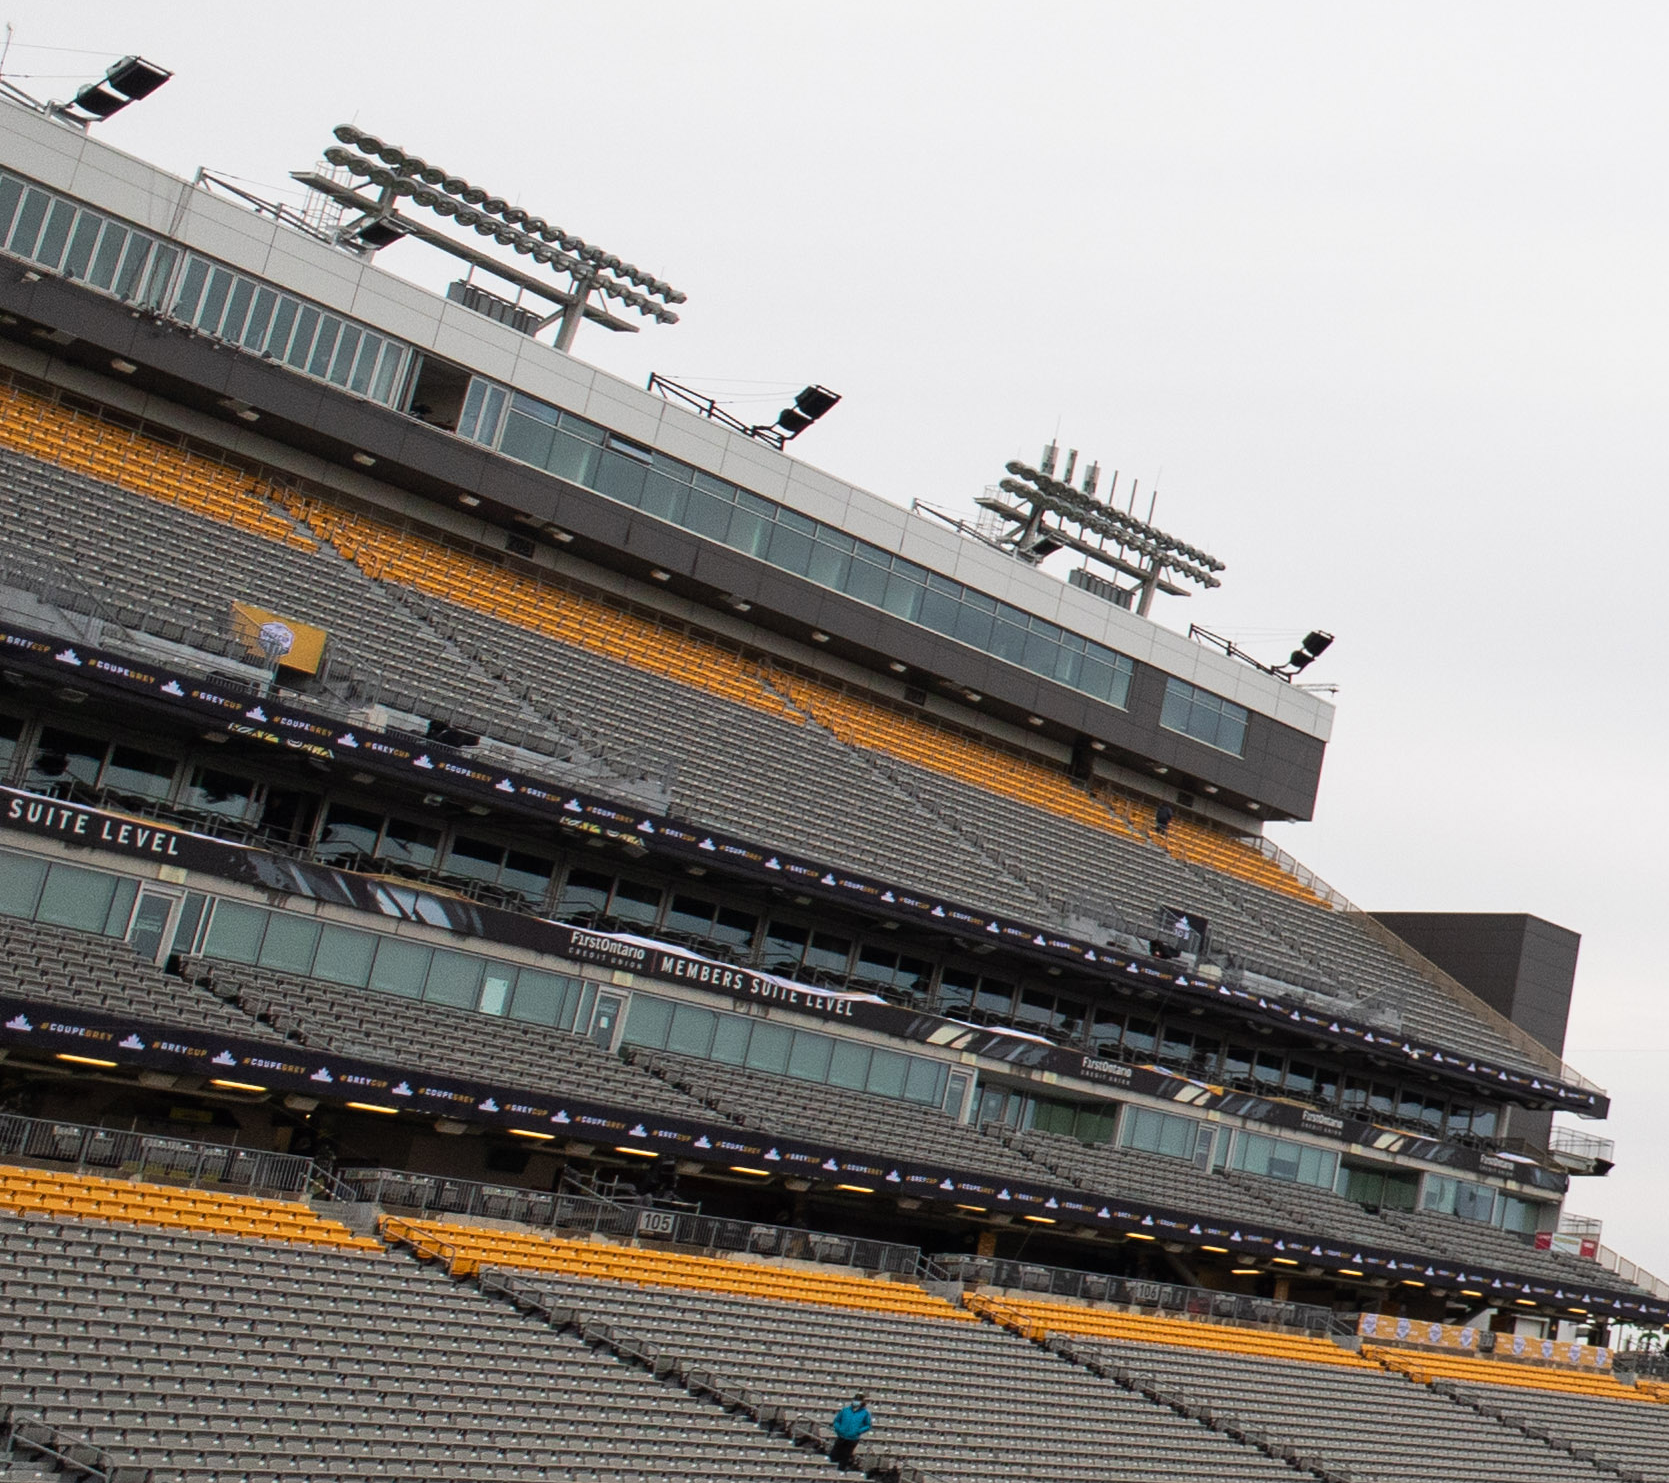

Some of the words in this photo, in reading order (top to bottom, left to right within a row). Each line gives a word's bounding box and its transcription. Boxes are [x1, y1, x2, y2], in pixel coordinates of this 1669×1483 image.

[9, 798, 89, 835] SUITE
[102, 820, 179, 856] LEVEL
[661, 956, 743, 991] MEMBERS
[806, 992, 854, 1017] LEVEL
[40, 1022, 114, 1042] #COUPEGREY
[152, 1041, 208, 1058] #GREYCUP
[642, 1215, 671, 1233] 105
[1139, 1282, 1158, 1300] 106
